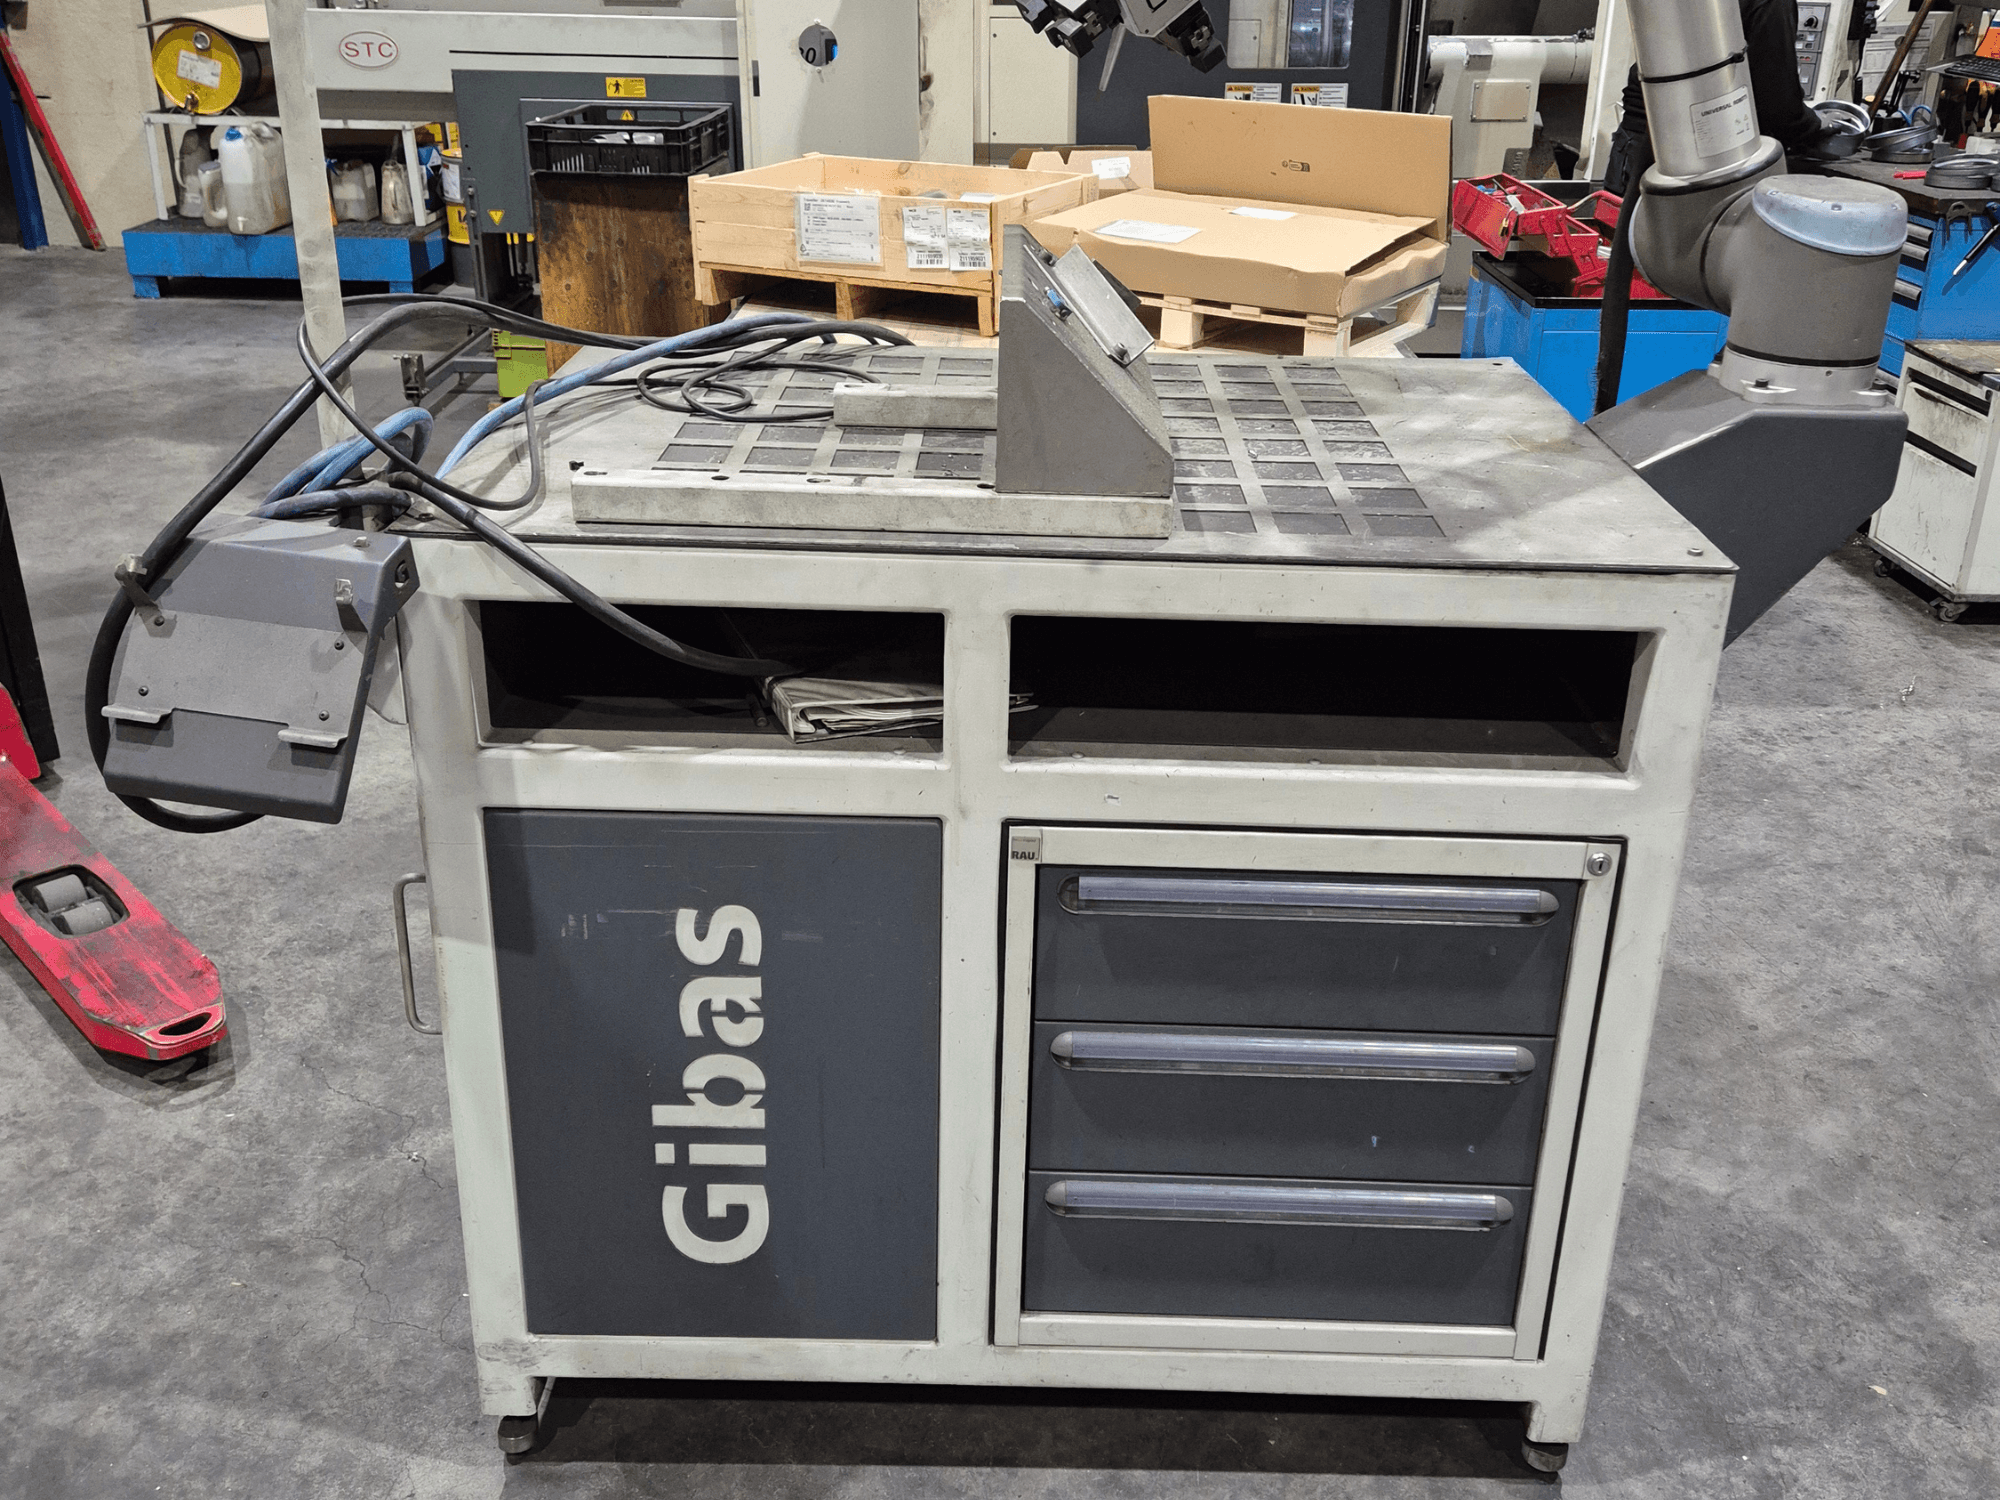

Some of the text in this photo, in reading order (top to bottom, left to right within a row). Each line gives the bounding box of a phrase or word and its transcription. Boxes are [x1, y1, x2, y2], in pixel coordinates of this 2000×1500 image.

[344, 41, 393, 58] STC
[1701, 102, 1732, 117] UNIVERSAL
[651, 904, 770, 1264] Gibas
